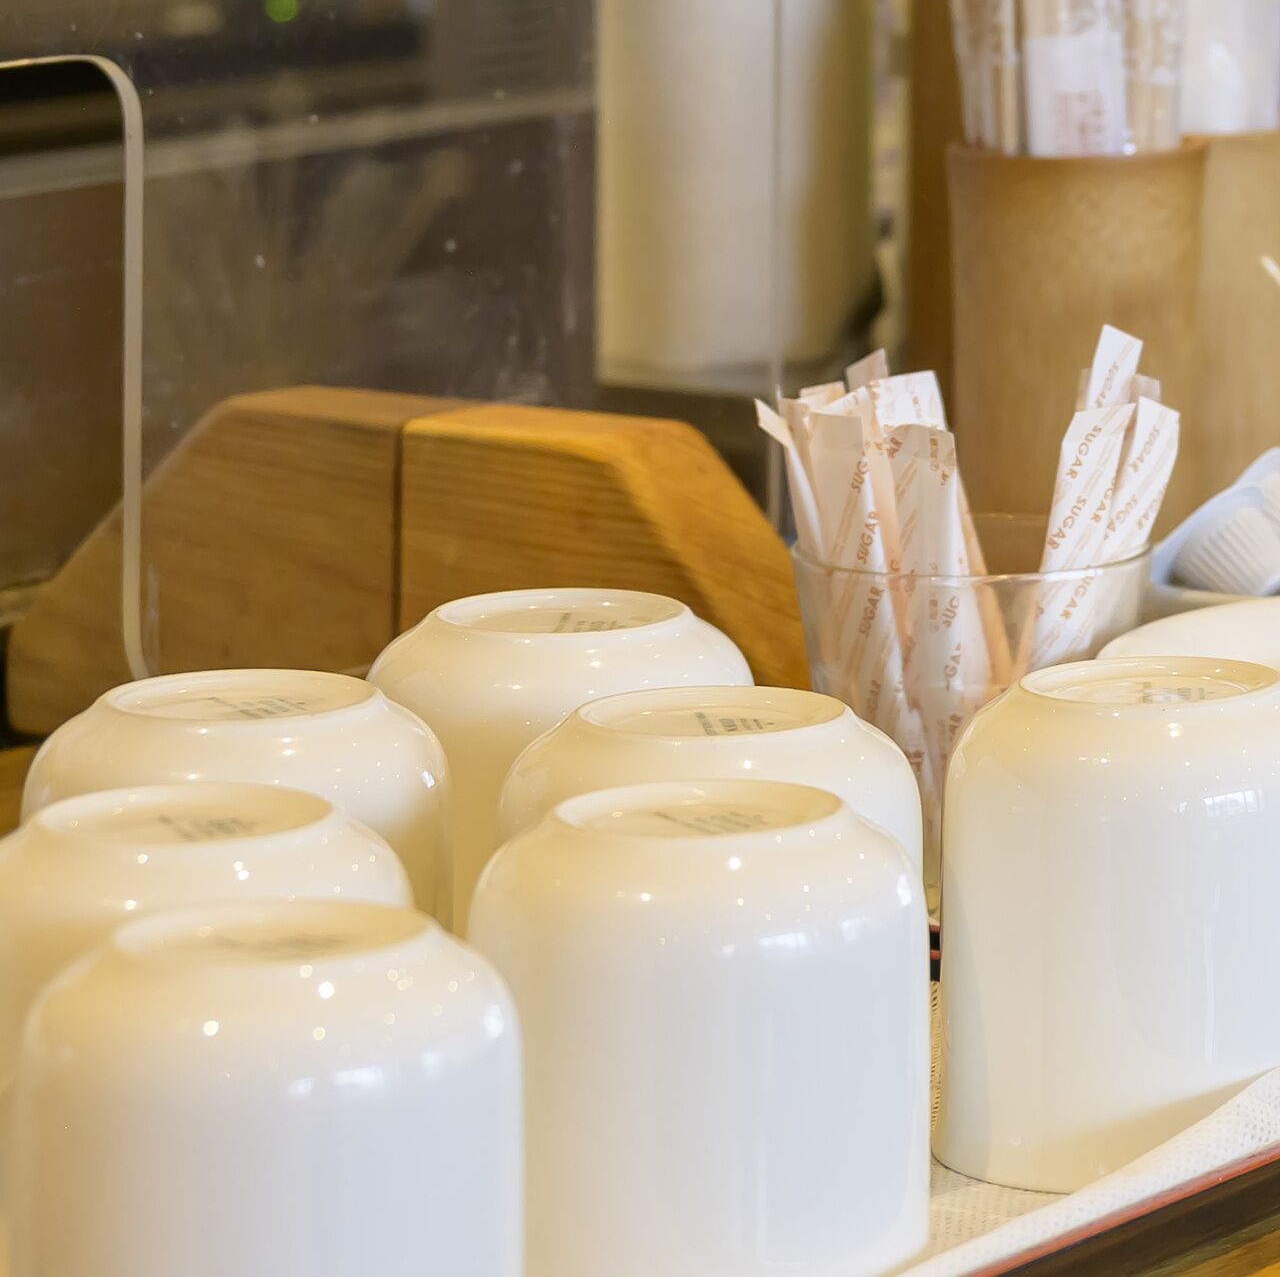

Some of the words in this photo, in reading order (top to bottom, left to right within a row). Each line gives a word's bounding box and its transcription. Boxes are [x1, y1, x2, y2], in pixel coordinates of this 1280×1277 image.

[1066, 424, 1103, 479] SUGAR
[1046, 494, 1087, 551] SUGAR
[858, 586, 885, 638] SUGAR
[1059, 575, 1094, 620] UGAR
